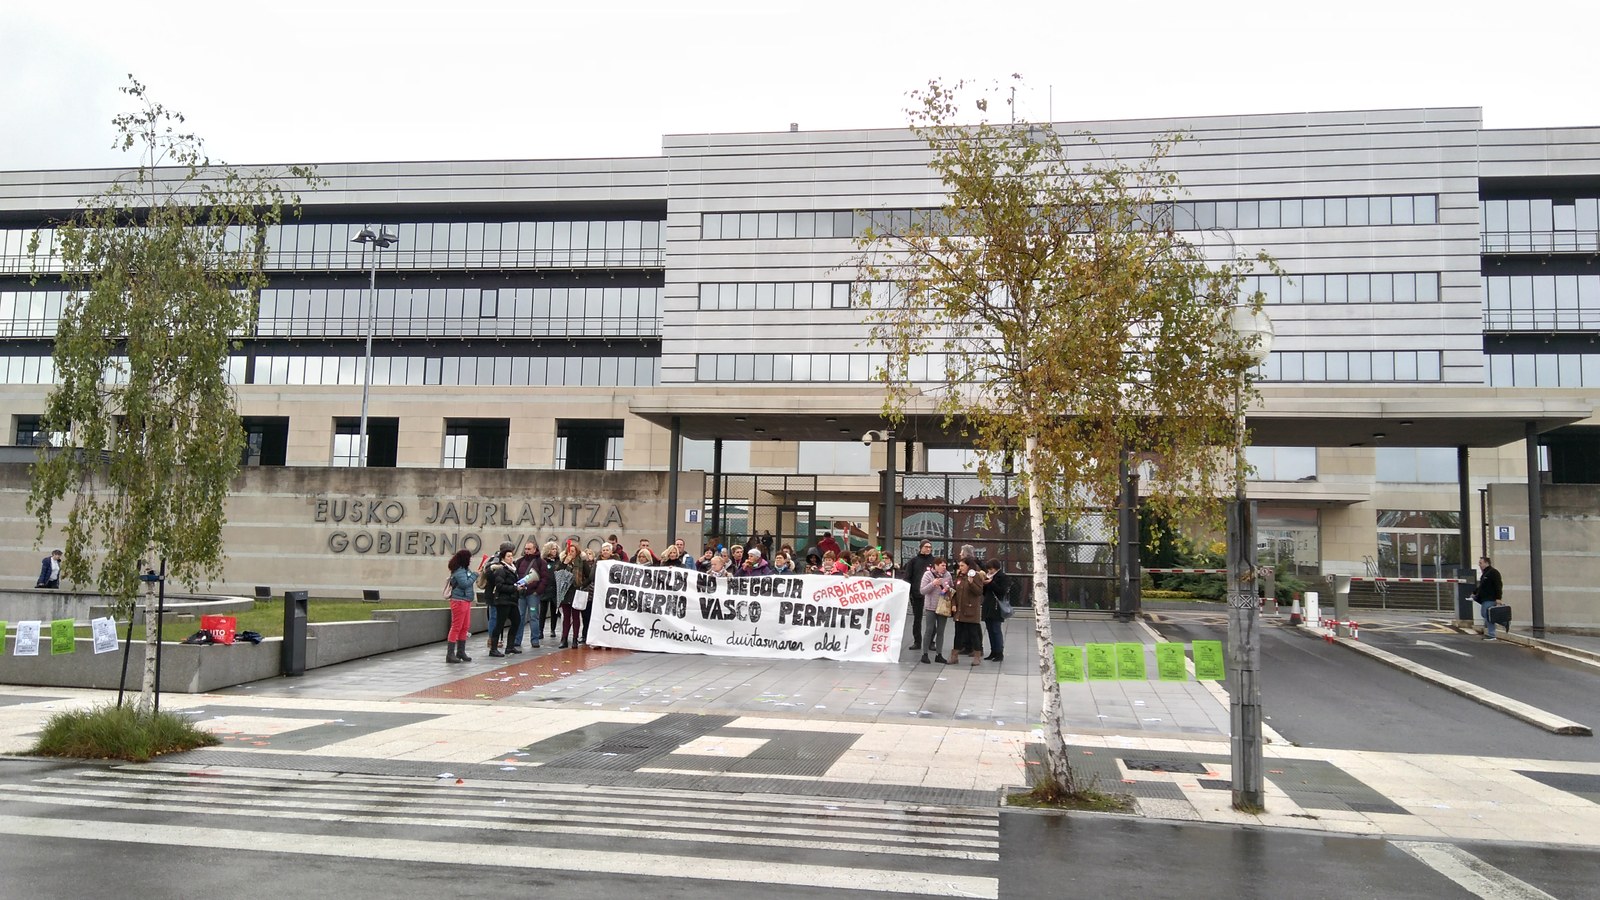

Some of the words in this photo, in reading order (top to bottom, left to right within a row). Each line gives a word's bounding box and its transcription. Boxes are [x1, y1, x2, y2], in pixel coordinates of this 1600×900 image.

[314, 500, 405, 524] EUSKO
[425, 502, 624, 528] JAURLARITZA
[328, 530, 482, 556] GOBIERNO
[608, 564, 688, 592] GARBIALDI
[696, 573, 717, 594] NO
[726, 577, 804, 599] NEGOCIA
[813, 580, 874, 602] GARBIKETA
[839, 583, 894, 607] BORROKAN
[605, 587, 688, 619] GOBIERNO
[699, 597, 762, 623] VASCO
[778, 601, 873, 635] PERMITE!
[875, 612, 890, 622] ELA
[875, 624, 890, 633] LAB
[871, 644, 889, 652] ESK
